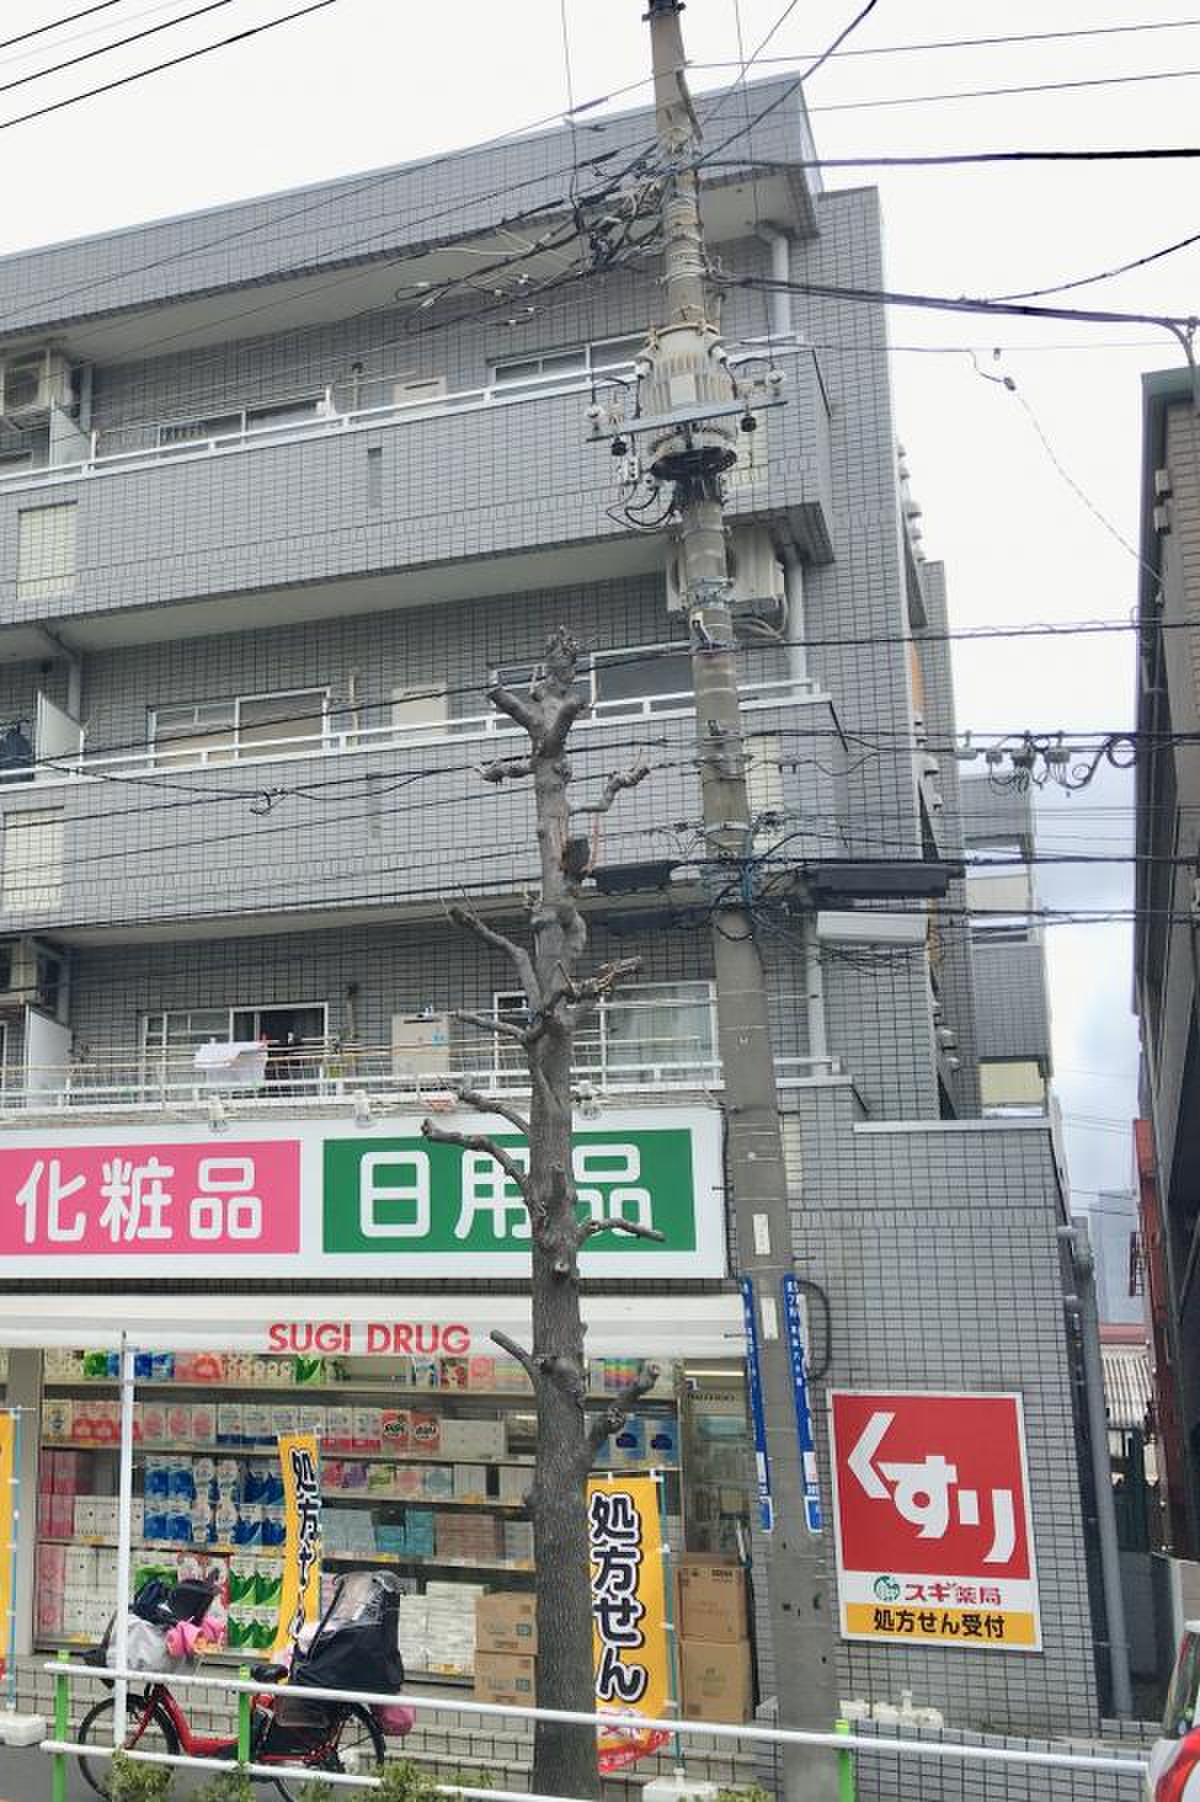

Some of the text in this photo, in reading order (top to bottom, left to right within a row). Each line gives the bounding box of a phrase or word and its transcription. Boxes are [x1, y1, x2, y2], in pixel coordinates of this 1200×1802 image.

[15, 1156, 263, 1243] 化粧品
[360, 1143, 653, 1239] 日用品
[269, 1322, 471, 1354] SUGI DRUG
[847, 1411, 1017, 1564] くすり
[588, 1491, 648, 1703] 処方せん
[873, 1609, 1006, 1640] 処方せん受付
[904, 1581, 1002, 1606] スギ薬局
